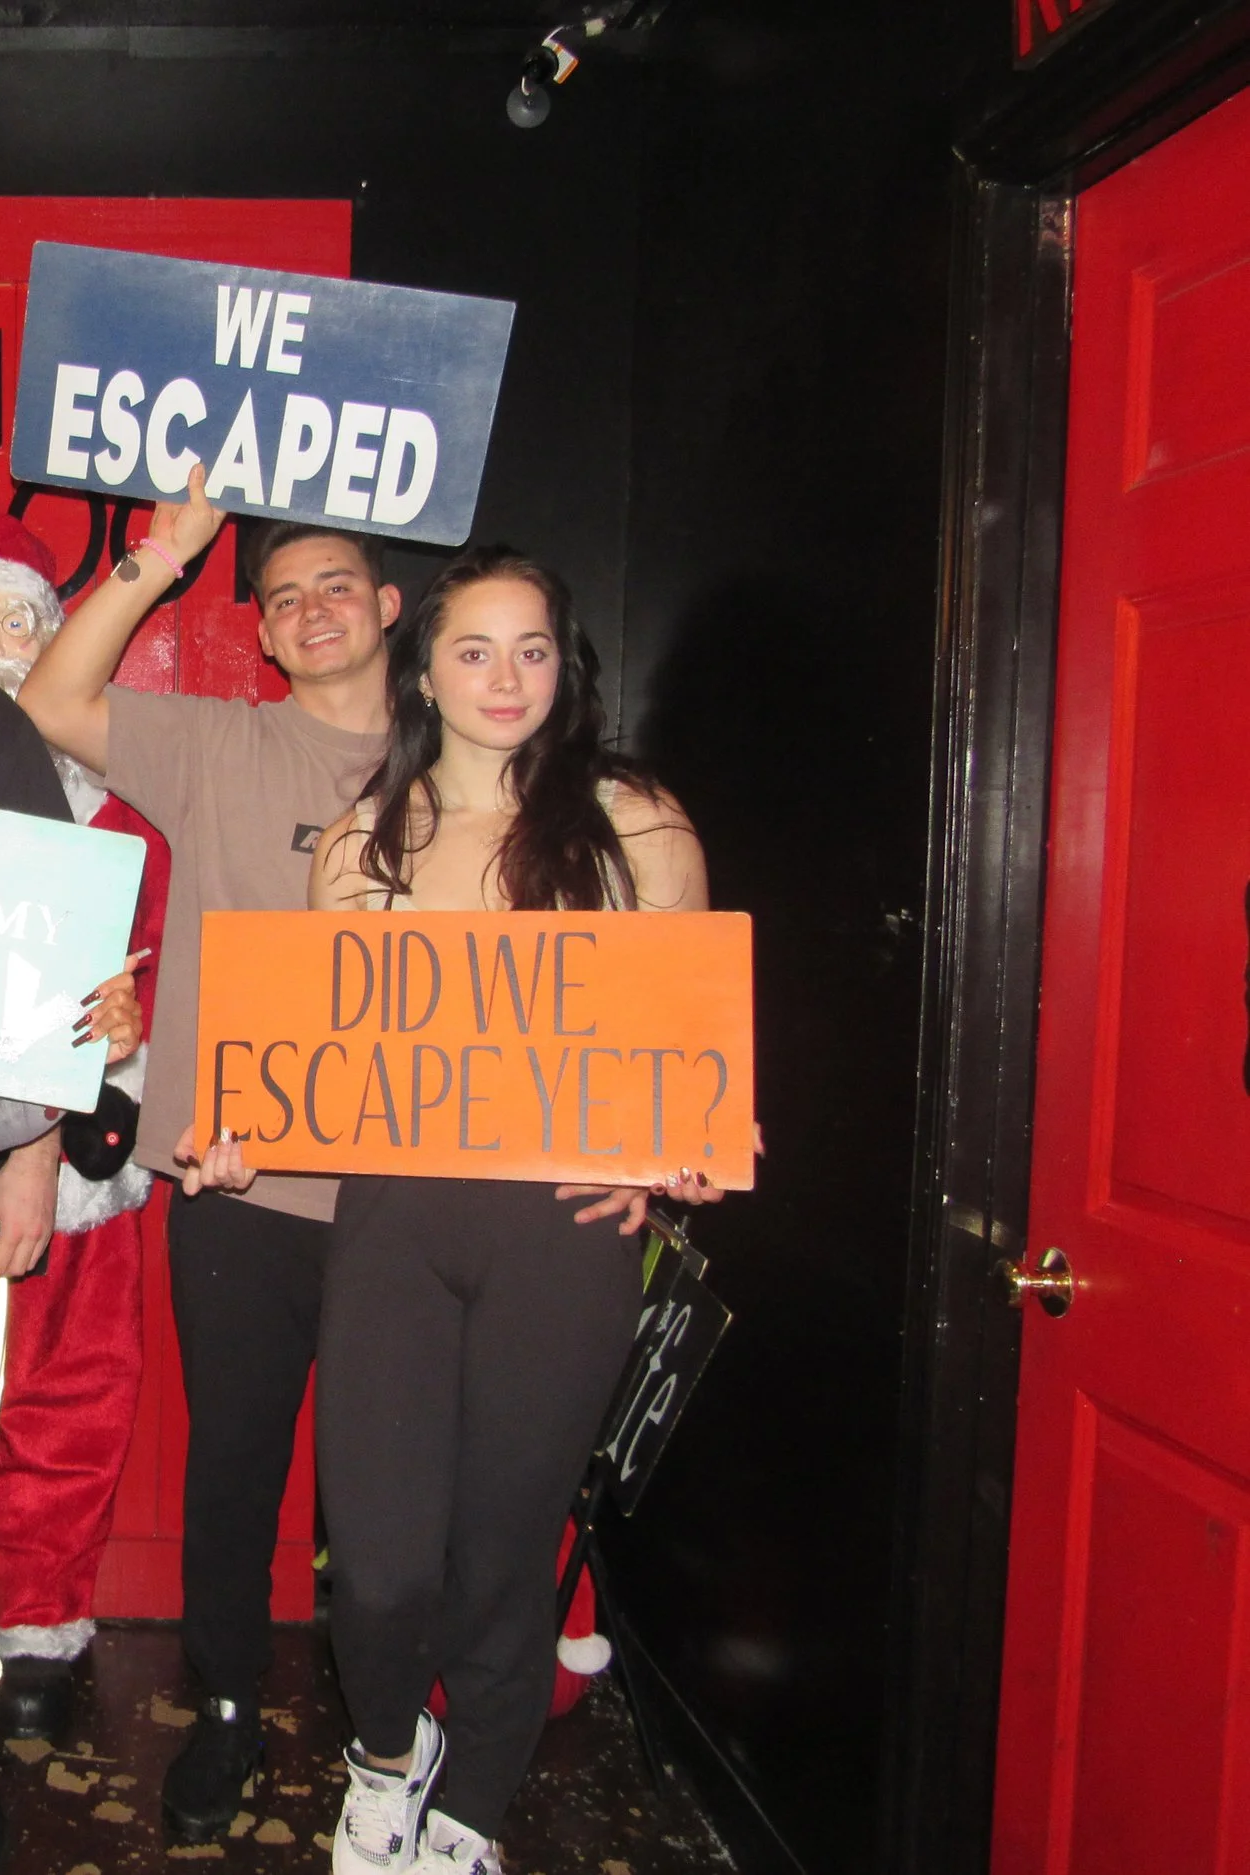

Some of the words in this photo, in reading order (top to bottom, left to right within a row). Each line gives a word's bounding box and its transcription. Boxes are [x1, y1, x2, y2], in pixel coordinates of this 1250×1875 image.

[214, 285, 312, 375] WE
[46, 363, 439, 526] ESCAPED
[330, 930, 442, 1033] DID
[465, 931, 598, 1037] WE
[212, 1040, 504, 1151] ESCAPE
[525, 1045, 729, 1159] YET?
